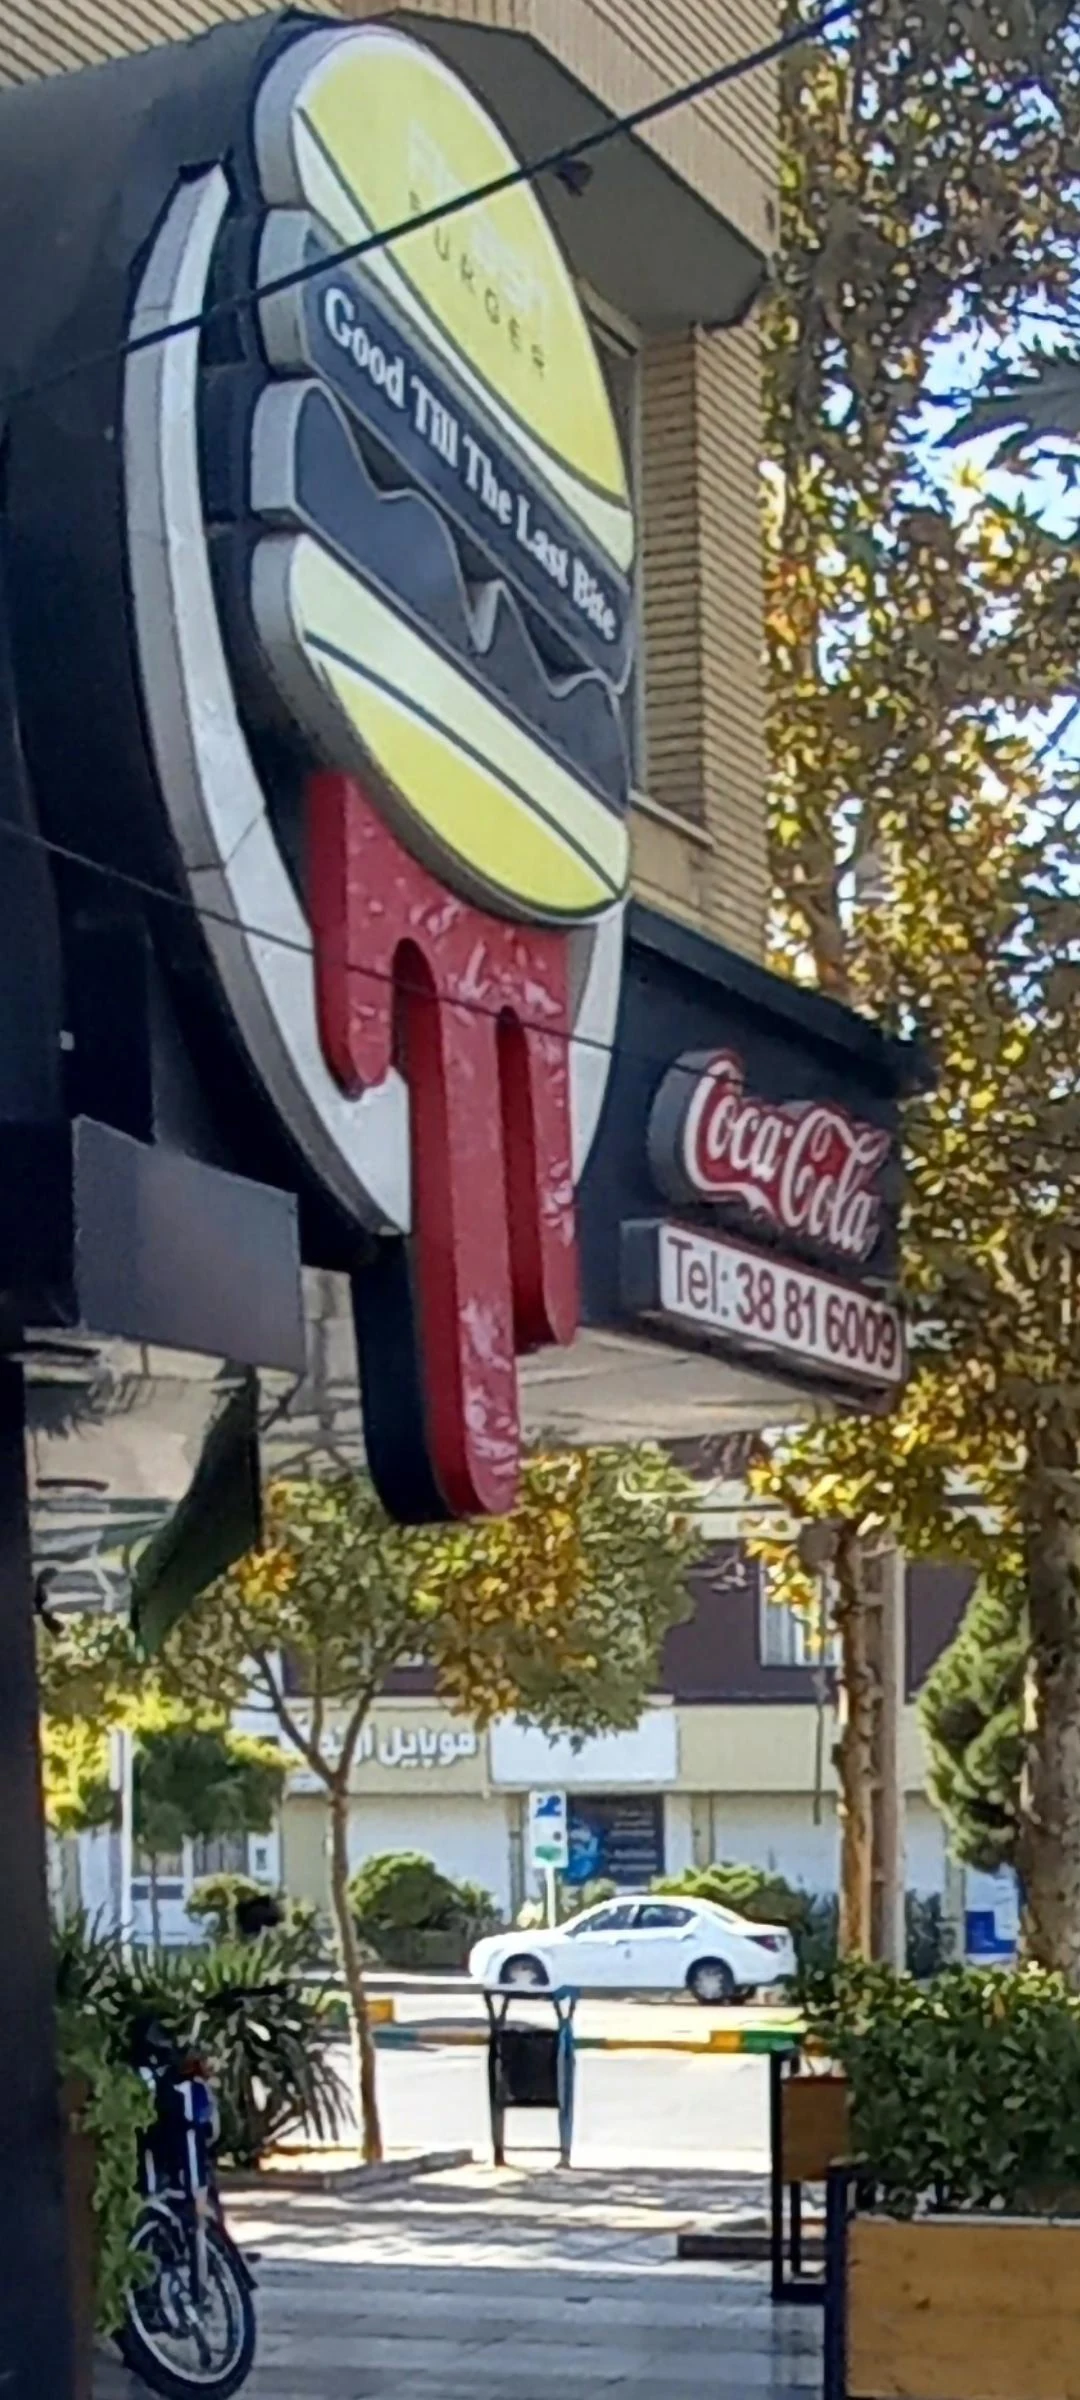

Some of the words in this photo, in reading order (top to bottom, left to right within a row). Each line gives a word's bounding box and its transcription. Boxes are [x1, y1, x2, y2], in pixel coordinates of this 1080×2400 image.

[324, 287, 405, 409] Good
[410, 374, 458, 469] Till
[462, 433, 513, 525] The
[516, 494, 569, 589] Last
[572, 556, 617, 642] Bite
[667, 1236, 730, 1318] Tel:
[735, 1261, 777, 1333] 38
[783, 1278, 817, 1346] 81
[824, 1293, 897, 1370] 6009
[379, 1726, 476, 1768] موبایل
